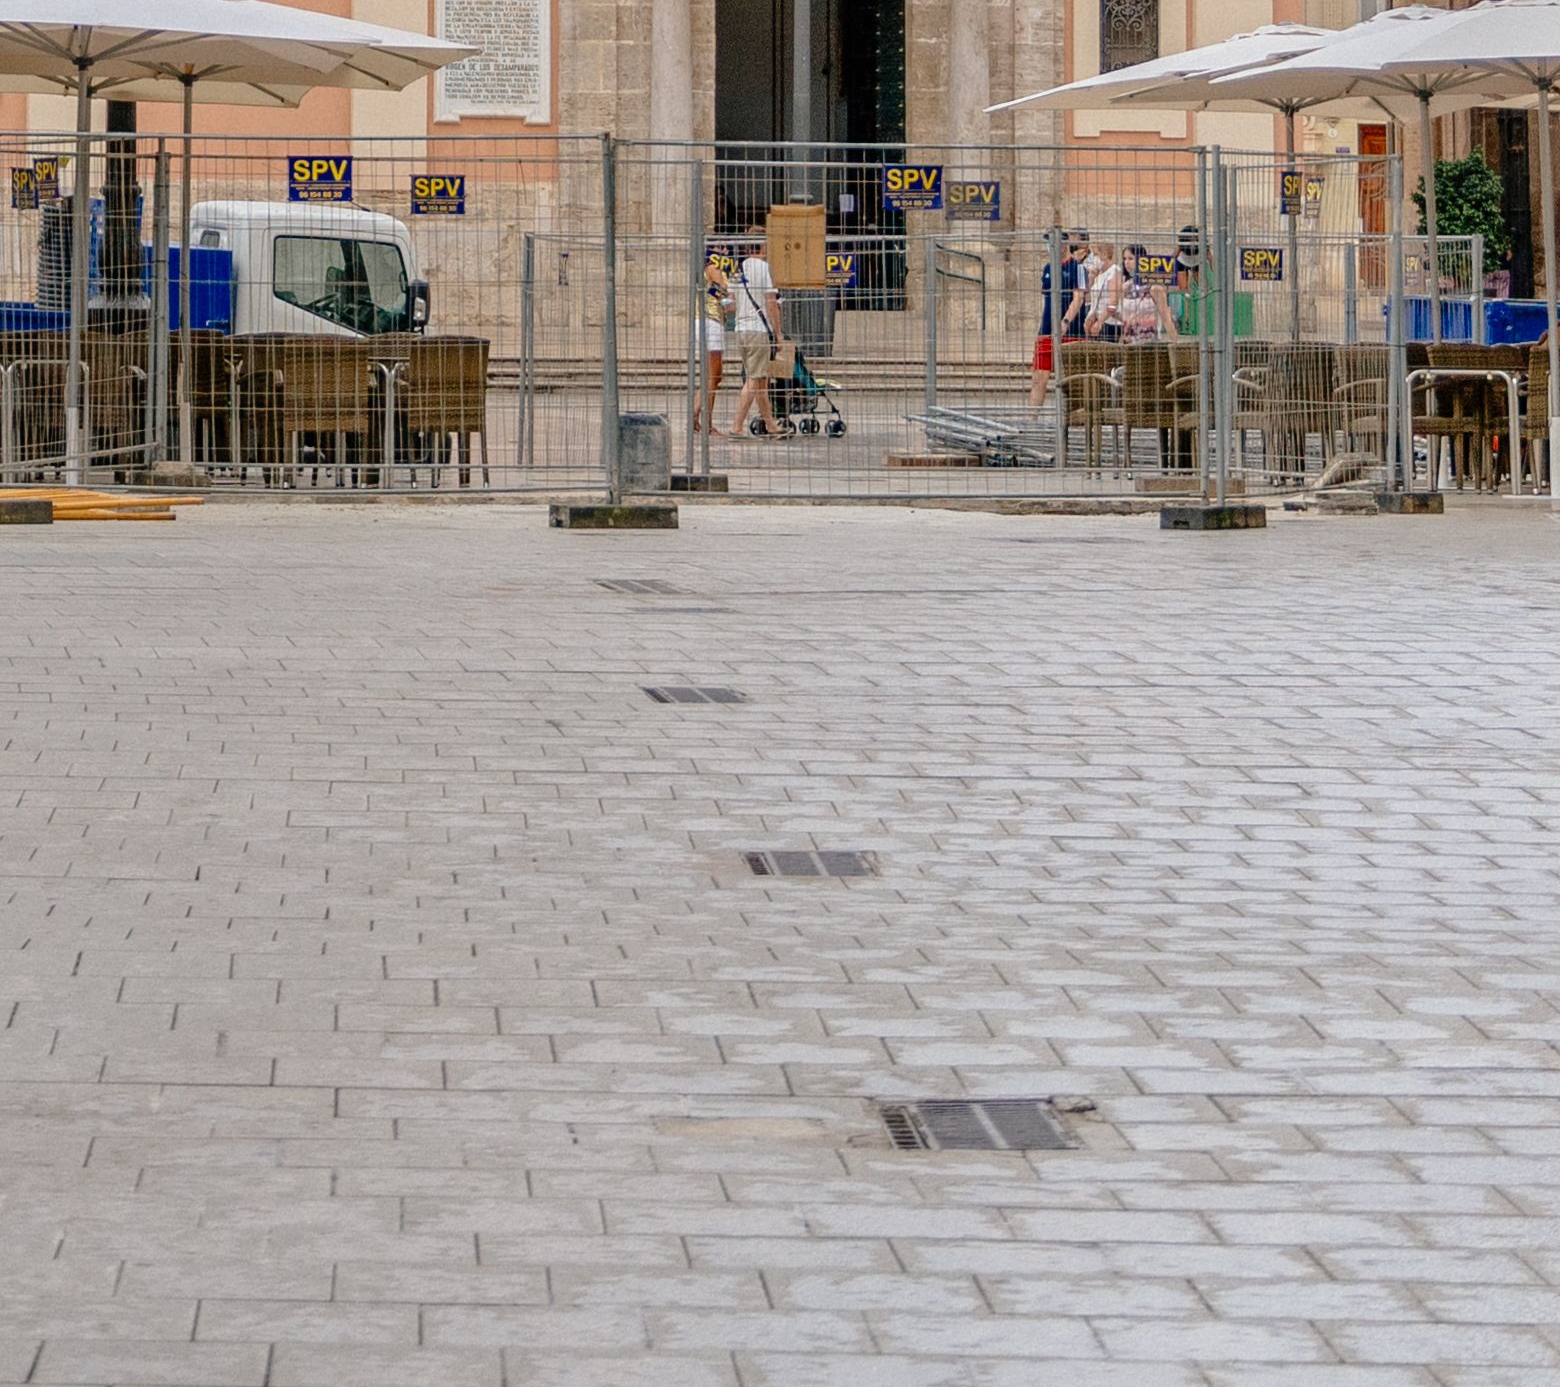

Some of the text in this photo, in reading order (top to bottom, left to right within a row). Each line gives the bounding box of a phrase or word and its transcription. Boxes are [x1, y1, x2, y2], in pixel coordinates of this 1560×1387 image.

[36, 161, 57, 181] SPV
[294, 159, 347, 181] SPV
[887, 168, 937, 190] SPV
[415, 178, 461, 197] SPV
[950, 184, 995, 203] SPV
[709, 253, 739, 274] SPV
[827, 255, 852, 272] PV
[1138, 257, 1175, 273] SPV
[1244, 250, 1280, 268] SPV
